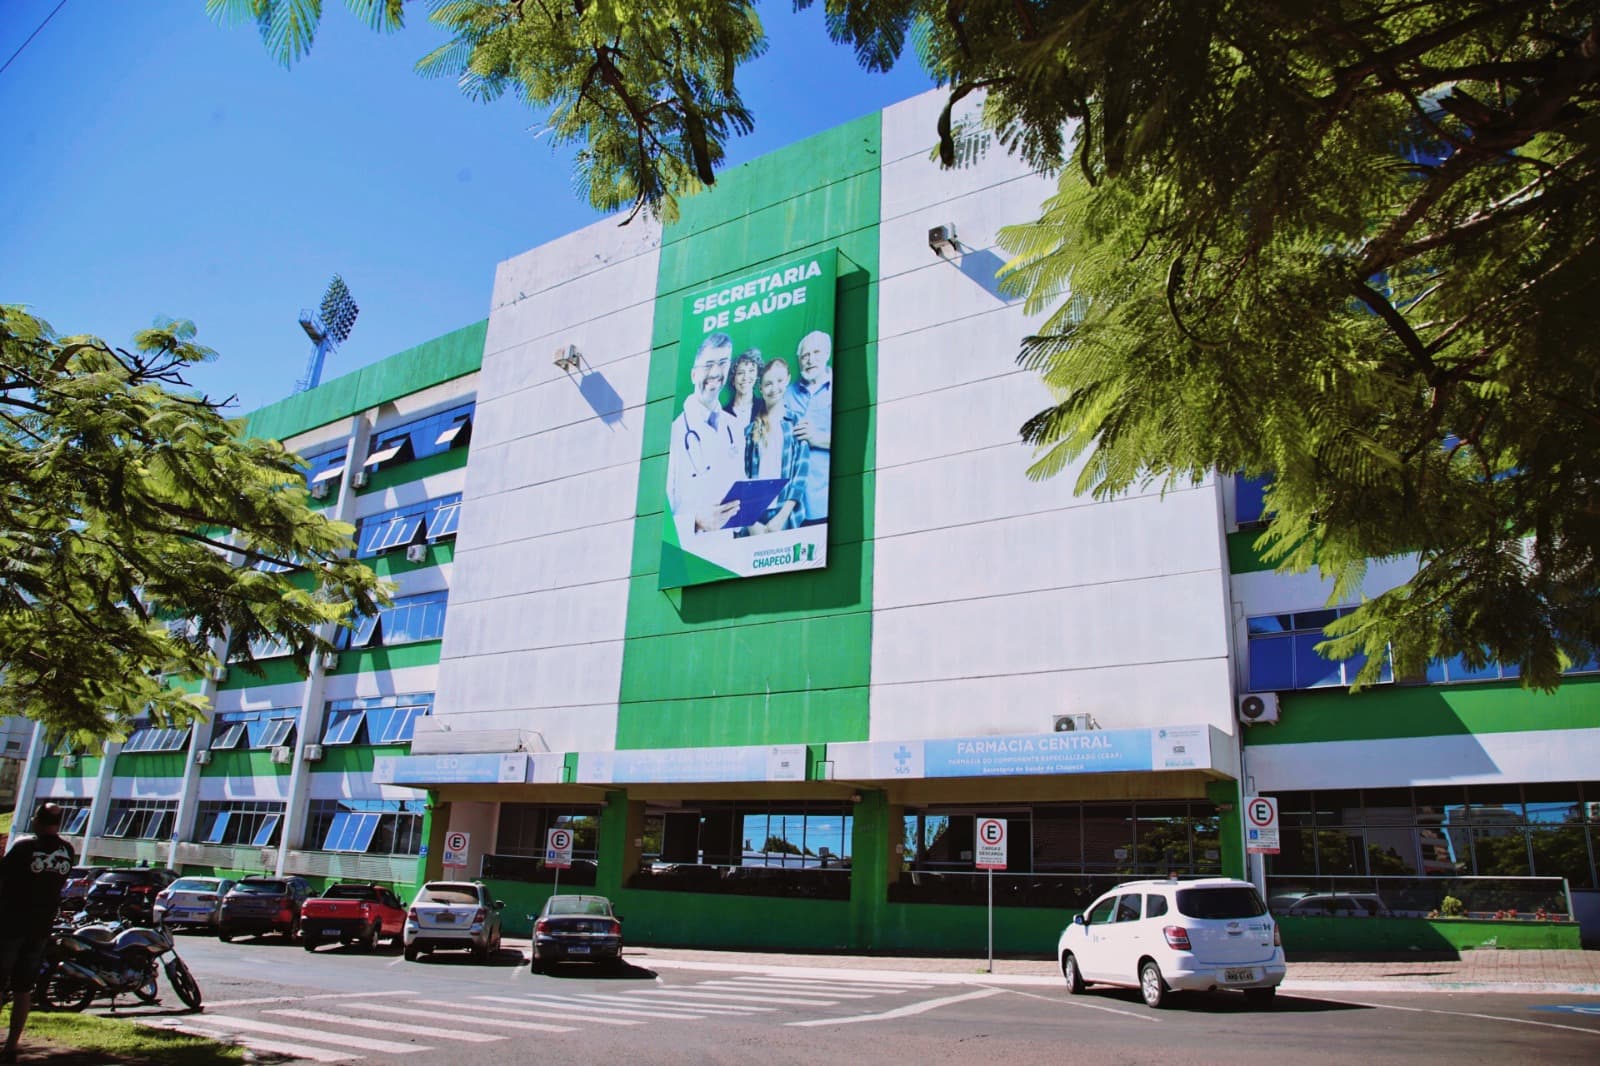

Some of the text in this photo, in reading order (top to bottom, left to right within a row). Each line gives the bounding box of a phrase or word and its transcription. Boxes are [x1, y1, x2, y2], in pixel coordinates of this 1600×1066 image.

[693, 261, 821, 314] SECRETARIA
[703, 286, 807, 333] DE SAÚDE
[753, 553, 791, 569] CHAPECÓ
[957, 735, 1112, 754] FARMÁCIA CENTRAL
[895, 767, 911, 775] SUS
[1256, 804, 1267, 821] E
[556, 834, 565, 846] E
[987, 825, 997, 840] E
[452, 837, 461, 848] E
